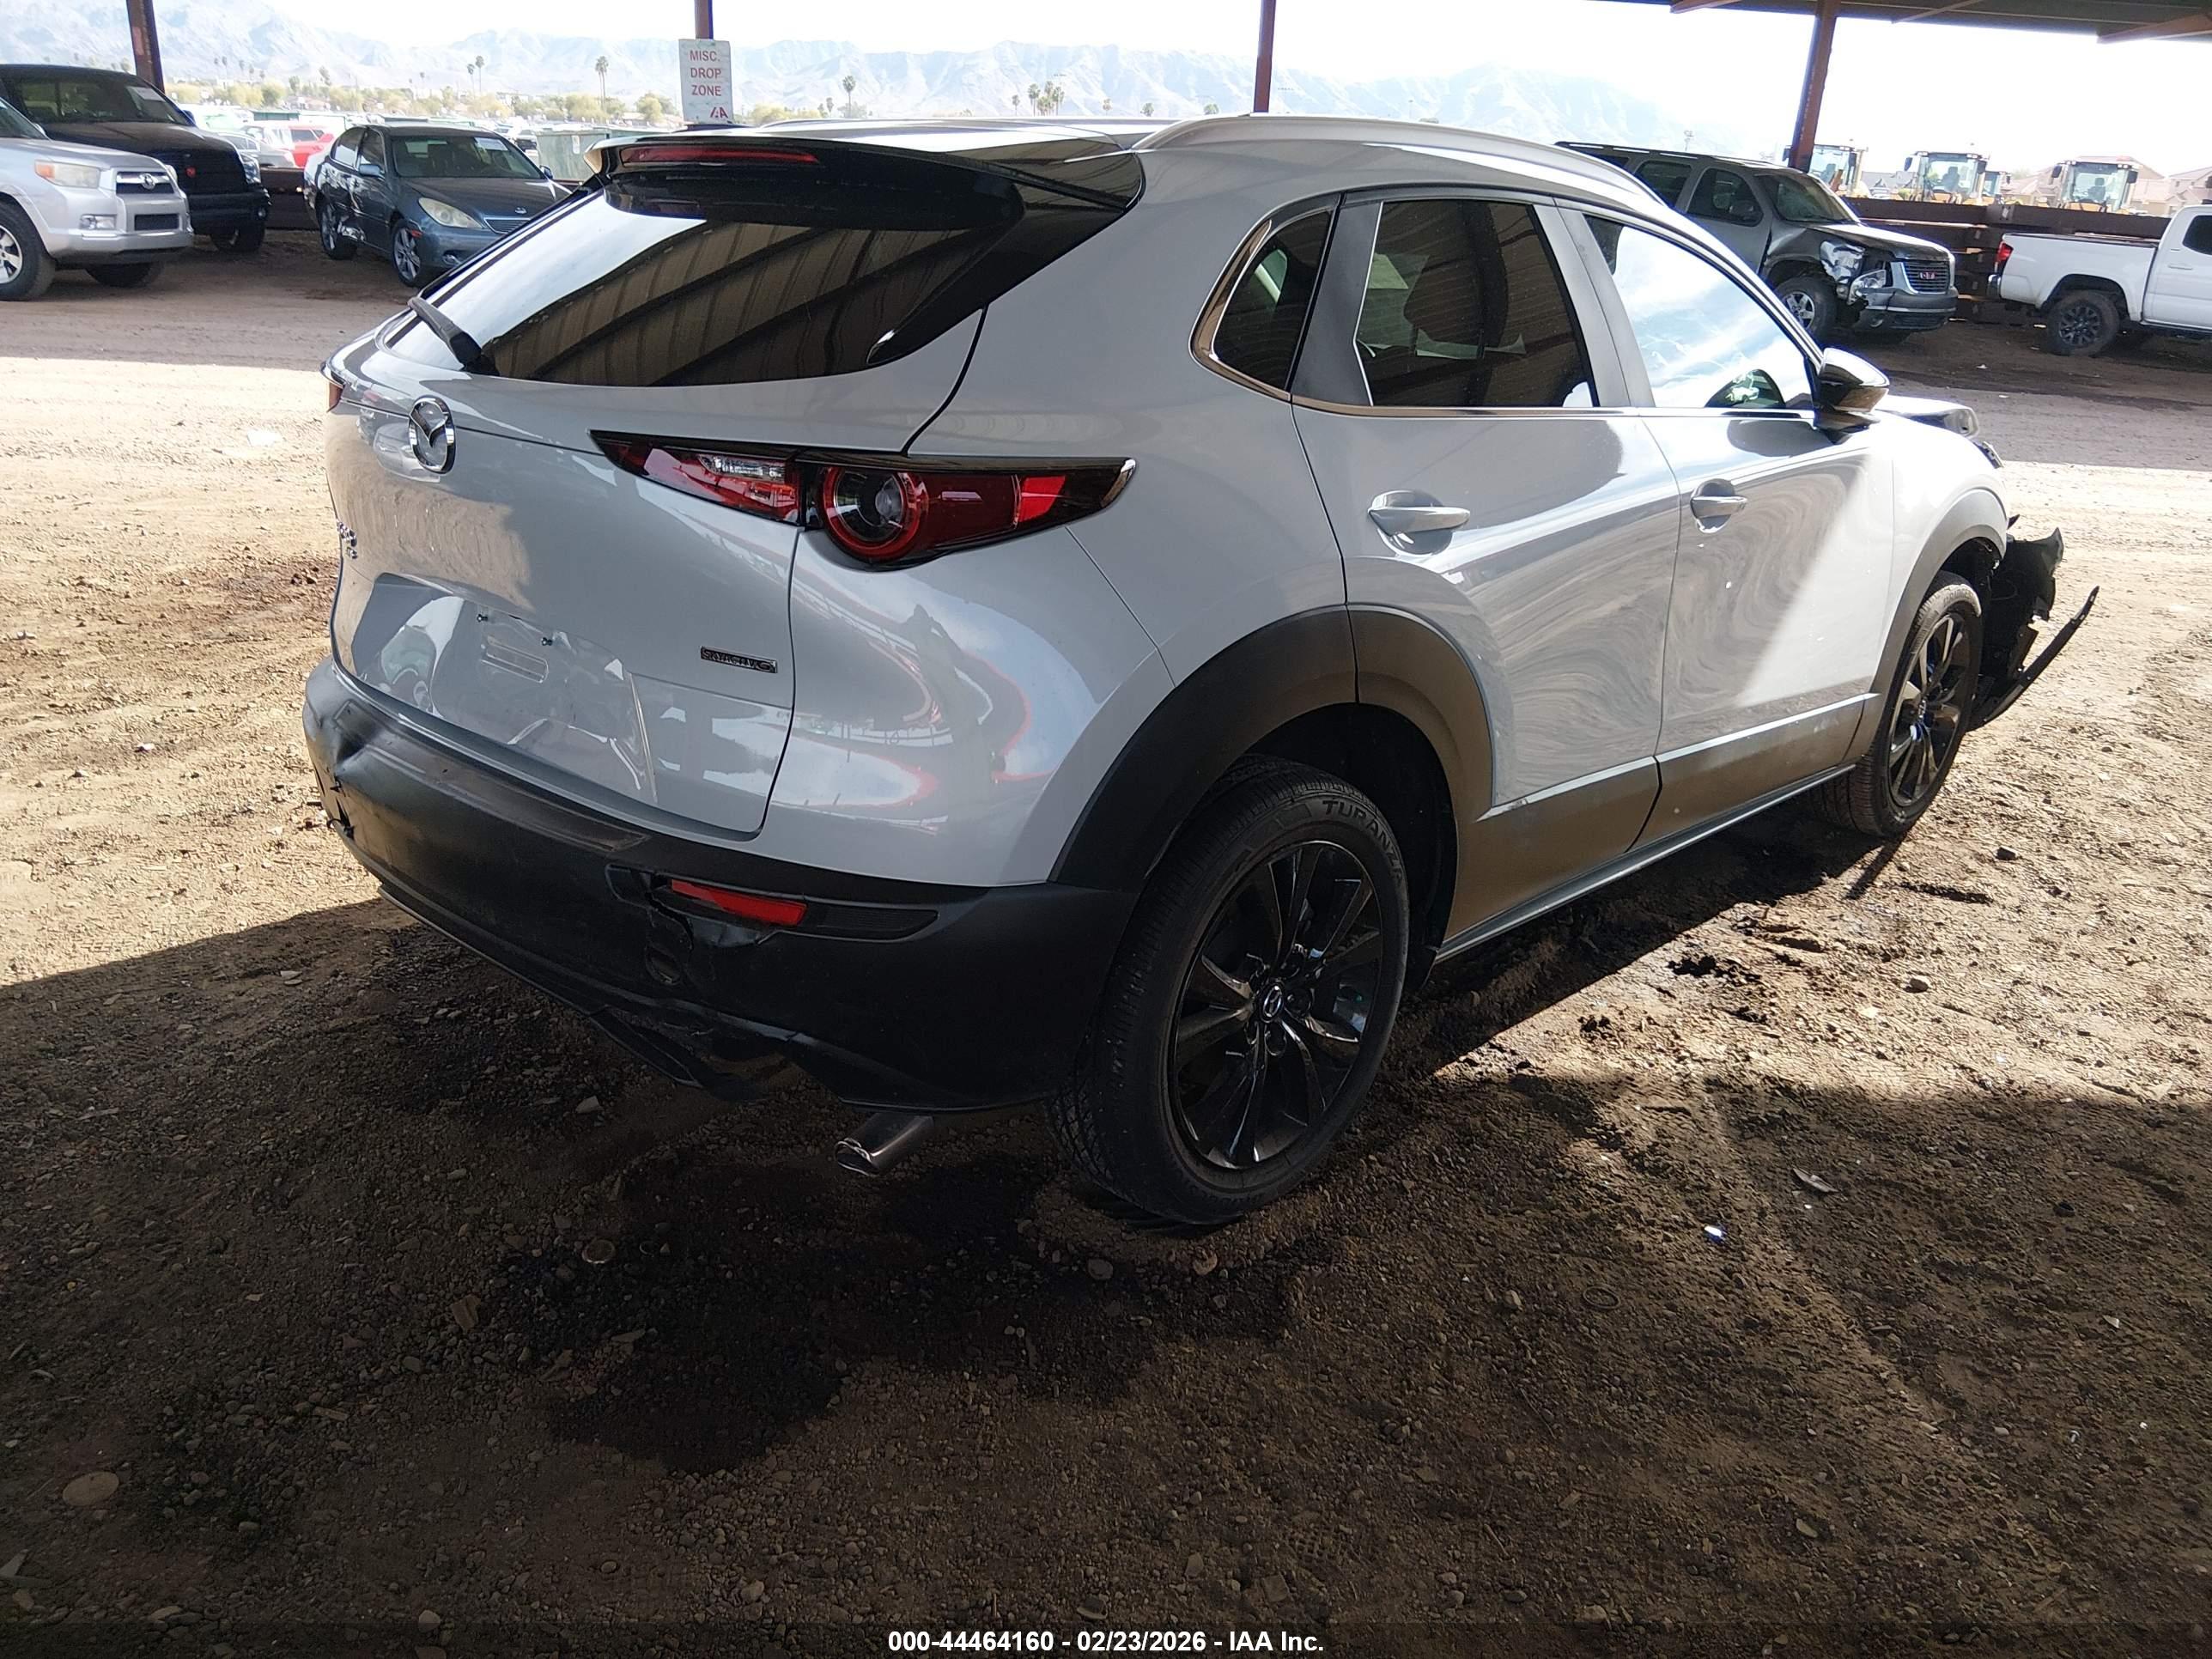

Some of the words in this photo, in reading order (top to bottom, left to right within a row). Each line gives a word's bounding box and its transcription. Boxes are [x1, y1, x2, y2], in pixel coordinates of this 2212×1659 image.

[690, 51, 720, 62] MISC.
[690, 68, 721, 79] DROP
[691, 84, 722, 96] ZONE
